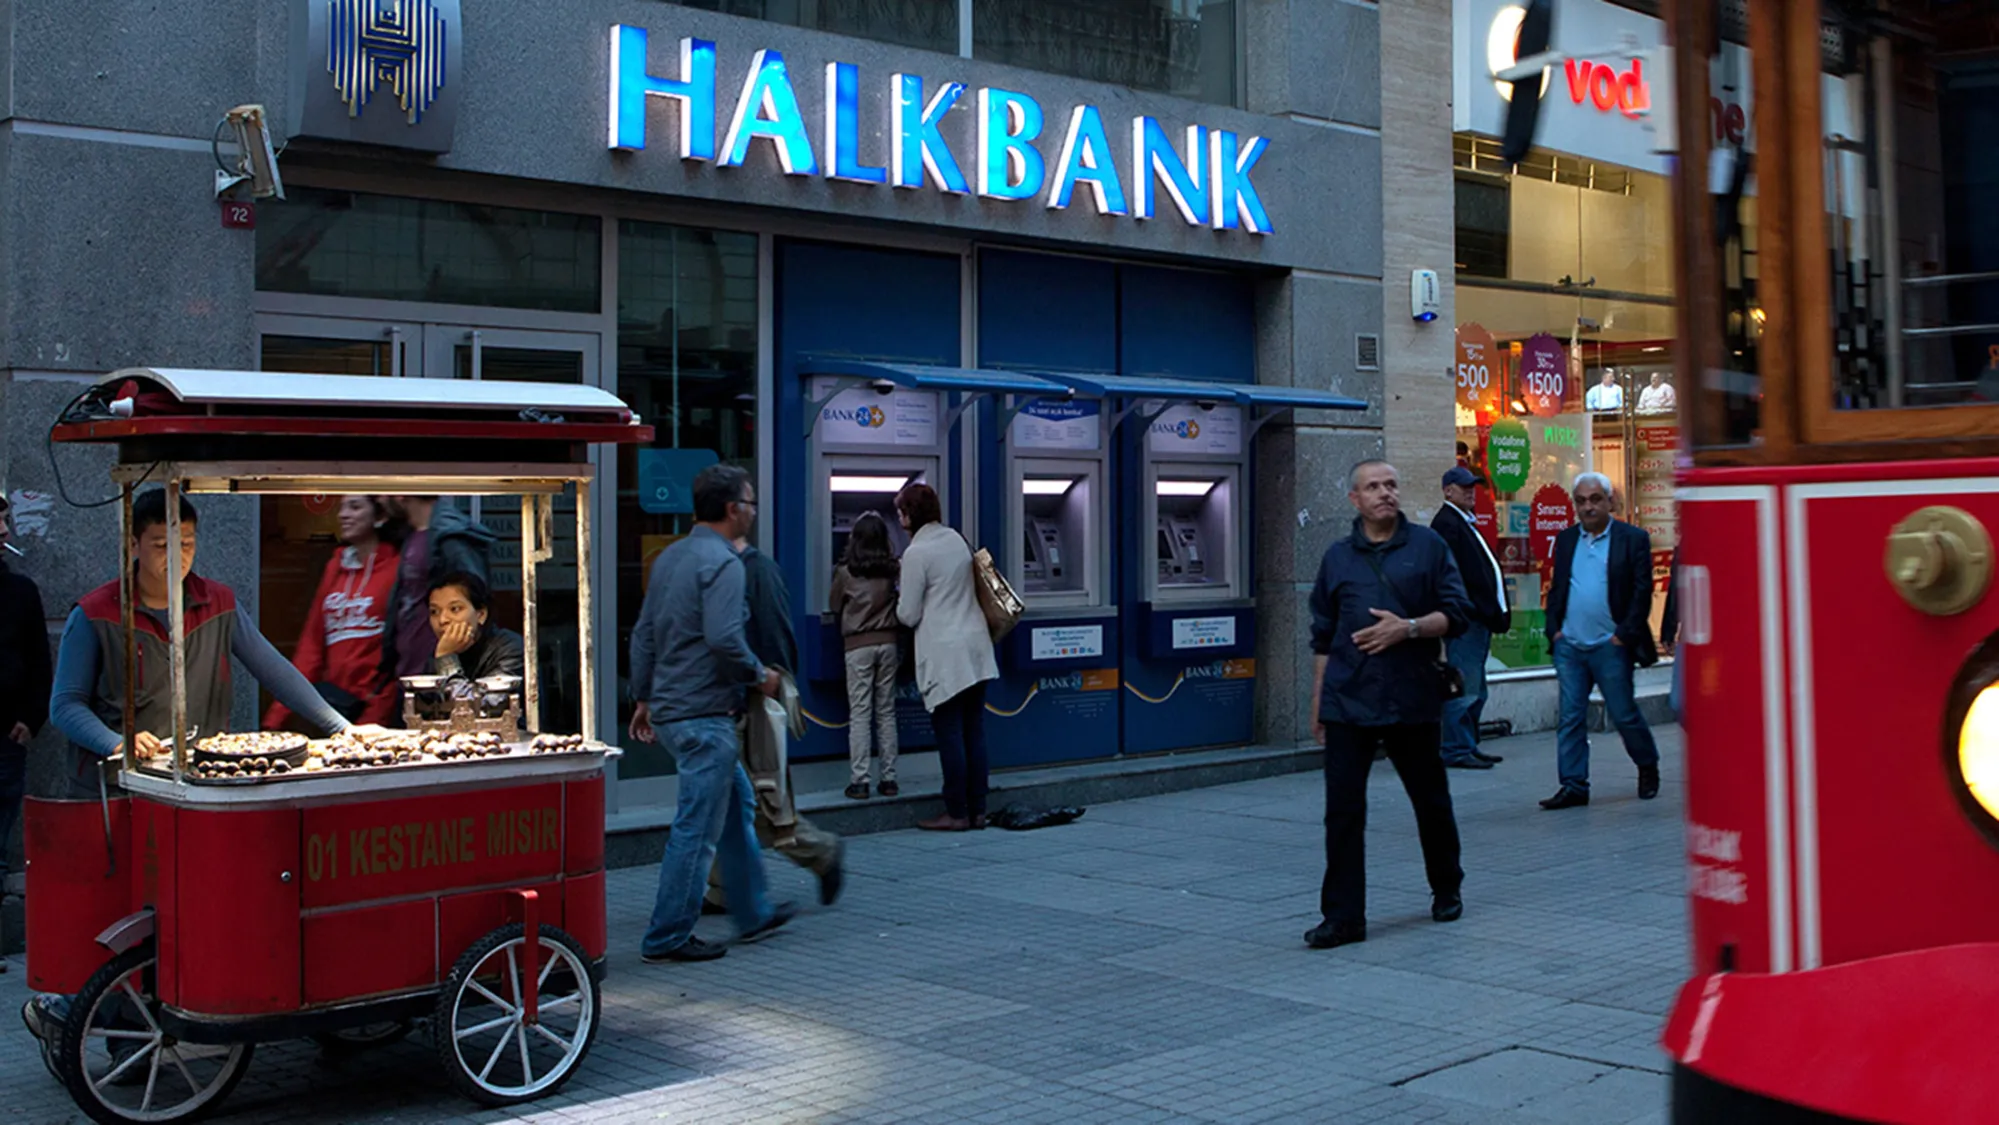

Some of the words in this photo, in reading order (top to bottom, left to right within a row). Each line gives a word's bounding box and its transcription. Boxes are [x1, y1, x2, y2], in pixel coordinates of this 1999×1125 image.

[608, 23, 1275, 235] HALKBANK
[231, 206, 249, 223] 72
[1457, 363, 1489, 389] 500
[1527, 371, 1563, 397] 1500
[307, 831, 338, 882] 01
[350, 817, 476, 877] KESTANE
[487, 807, 558, 857] MISIR
